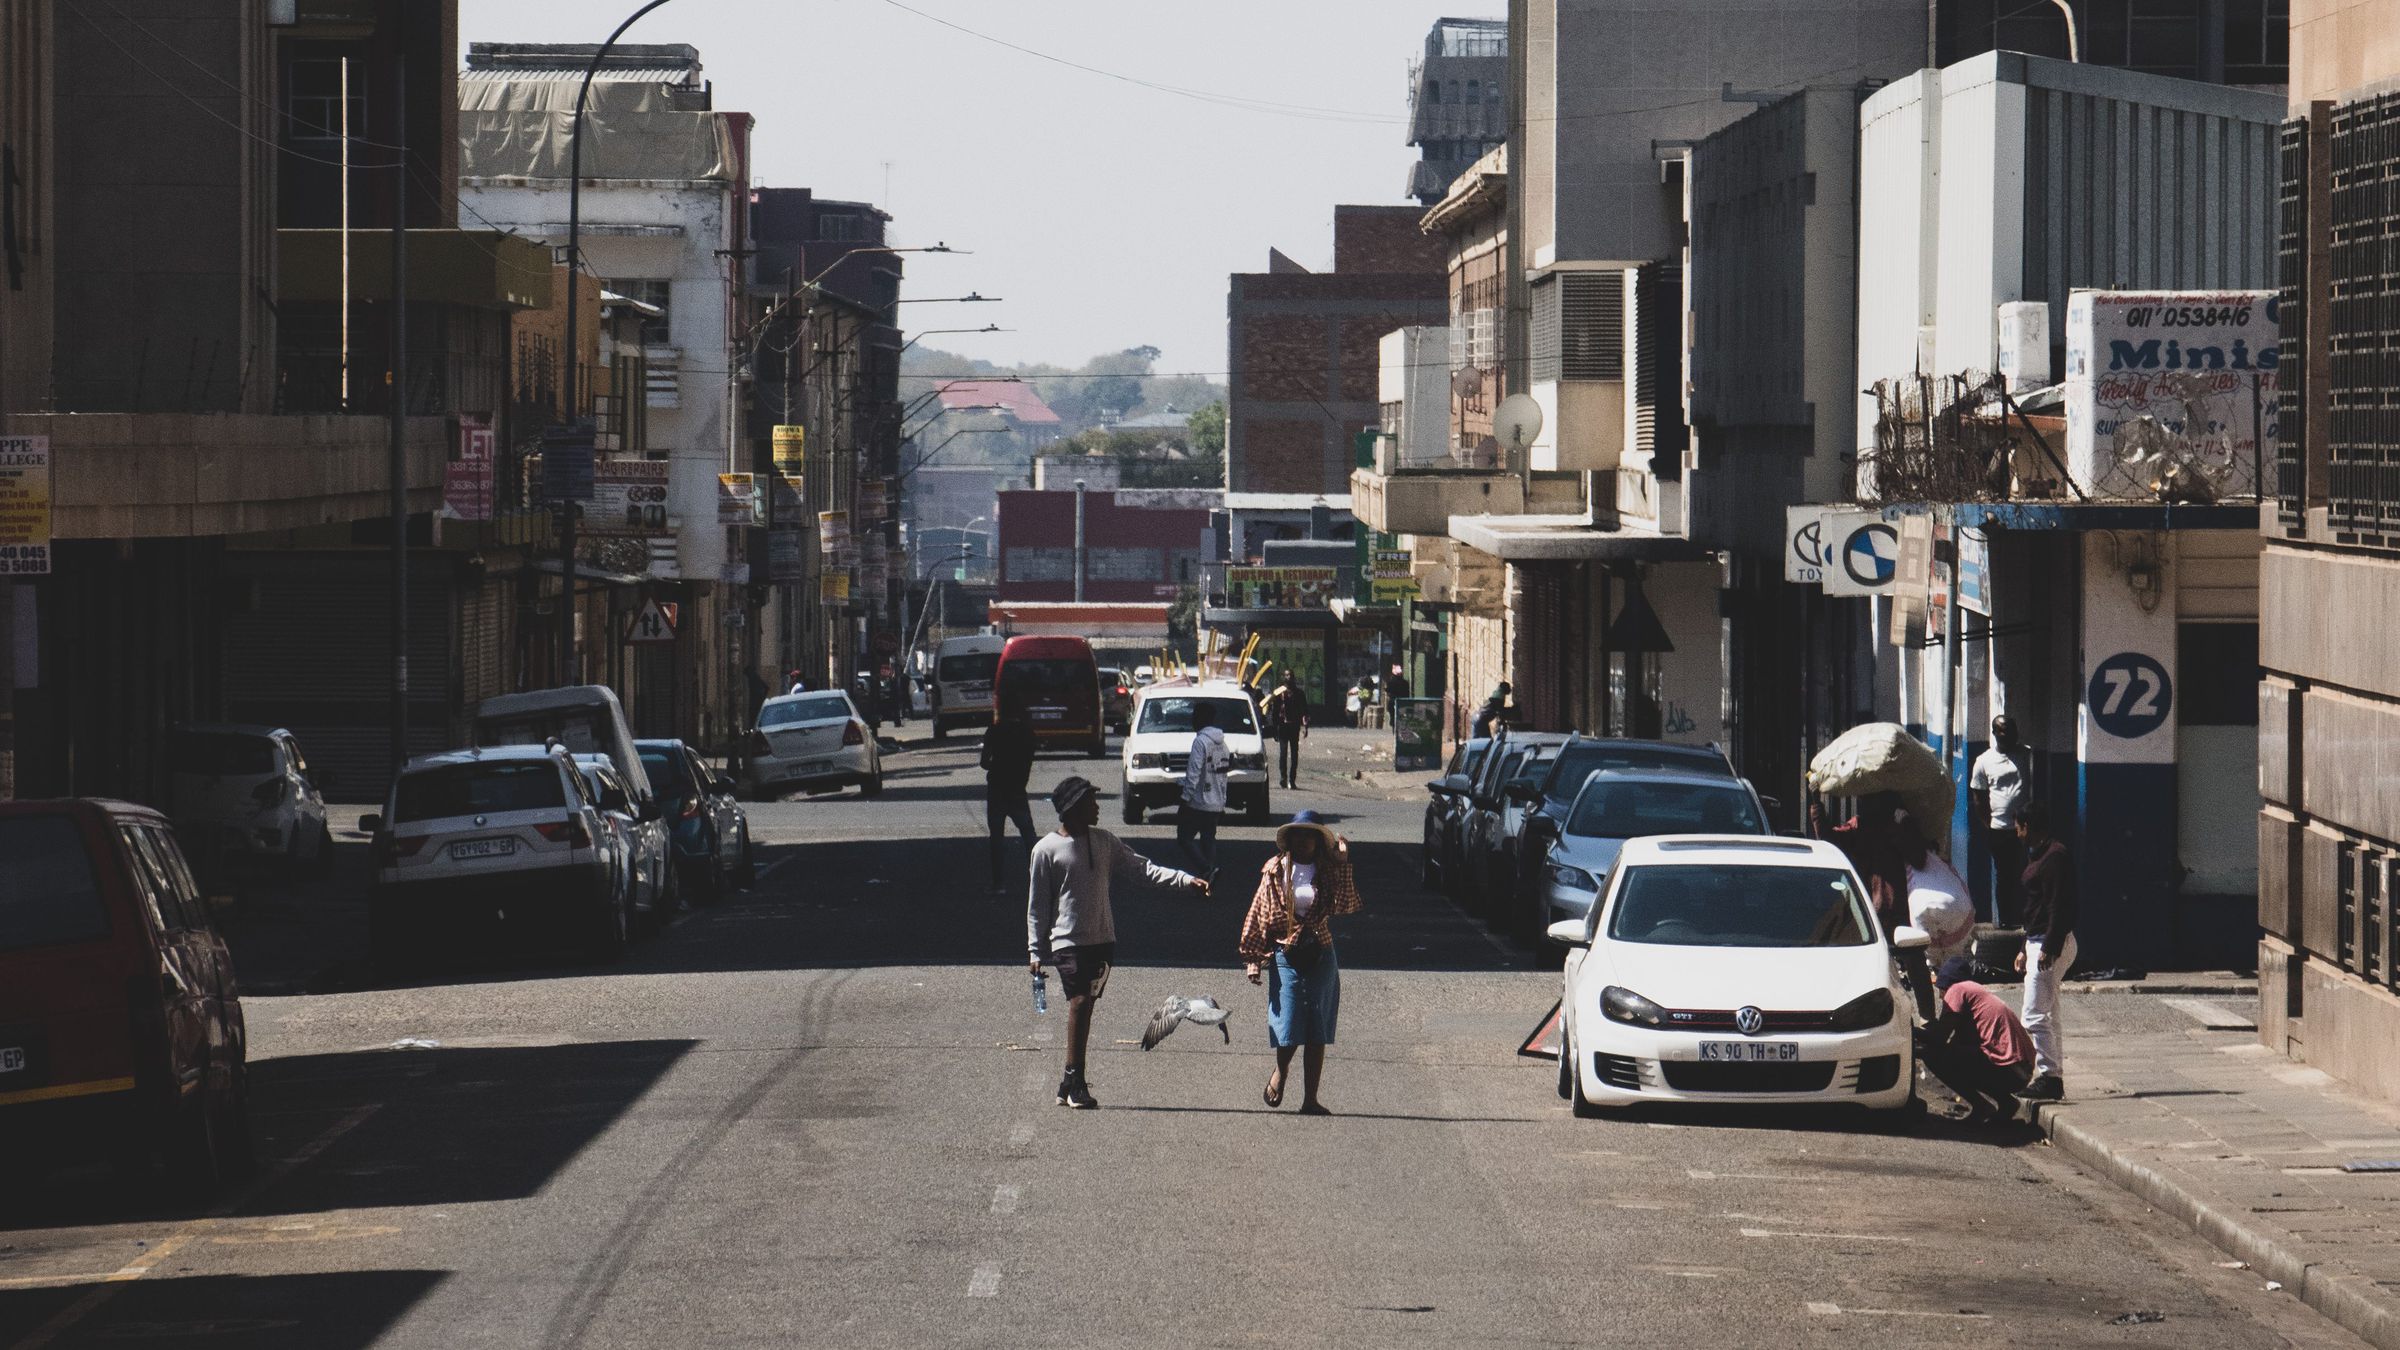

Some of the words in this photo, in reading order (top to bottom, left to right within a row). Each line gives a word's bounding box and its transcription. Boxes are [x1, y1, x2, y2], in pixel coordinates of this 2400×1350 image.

[620, 462, 666, 475] REPAIRS
[2102, 666, 2161, 716] 72
[4, 1051, 22, 1068] GP
[1701, 1044, 1719, 1058] KS
[1726, 1044, 1742, 1059] 90
[1749, 1044, 1765, 1060] TH
[1780, 1045, 1796, 1060] GP
